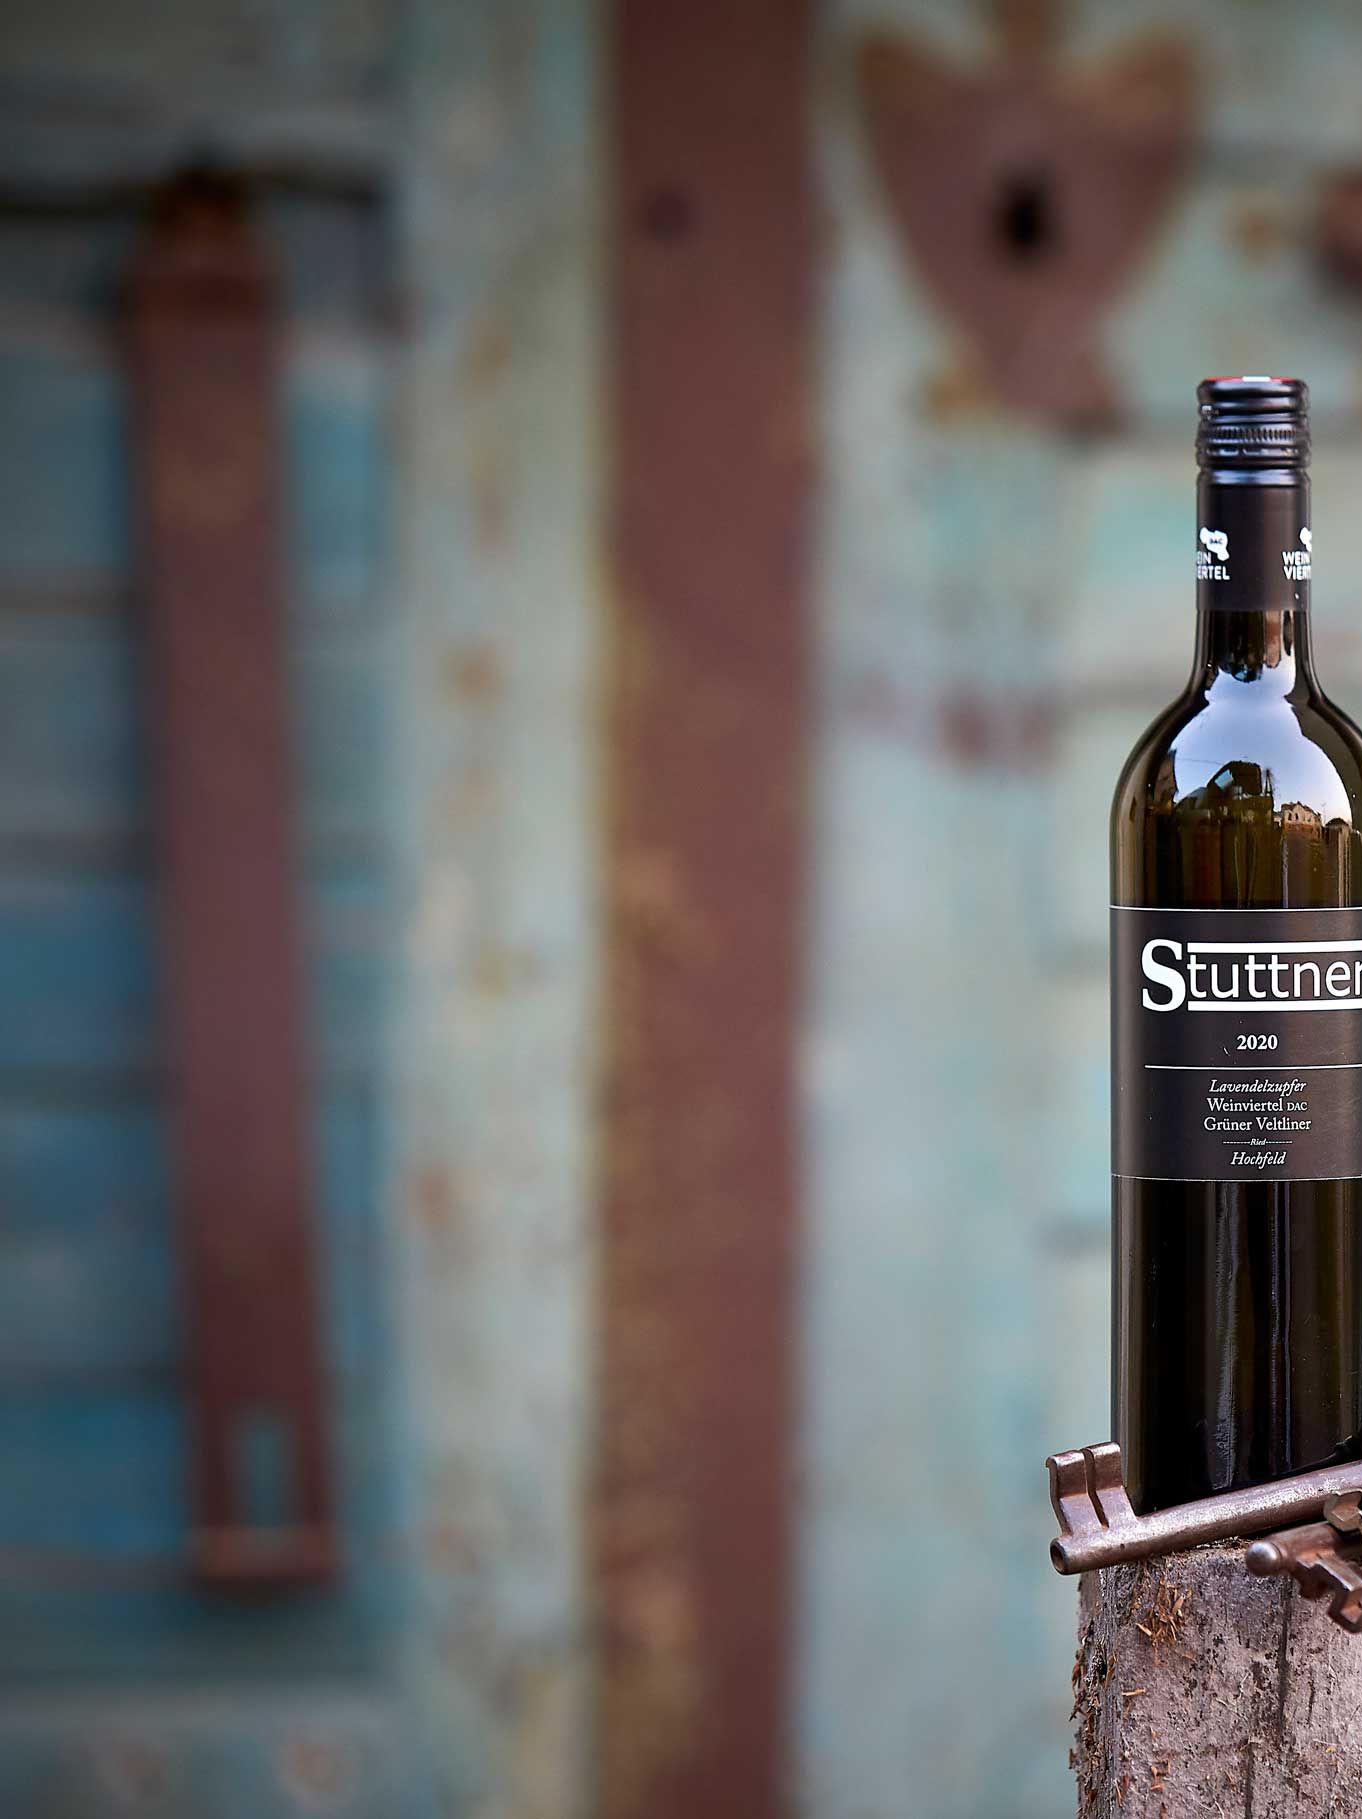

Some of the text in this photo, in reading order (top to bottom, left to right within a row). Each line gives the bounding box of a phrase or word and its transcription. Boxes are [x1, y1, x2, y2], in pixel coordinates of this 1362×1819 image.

[1236, 1034, 1279, 1051] 2020
[1209, 1079, 1306, 1096] Lavendelzupfer
[1206, 1097, 1308, 1112] Weinviertel DAC
[1203, 1116, 1312, 1131] Grüner Veltliner
[1249, 1138, 1267, 1146] Ried
[1230, 1152, 1287, 1169] Hochfeld
